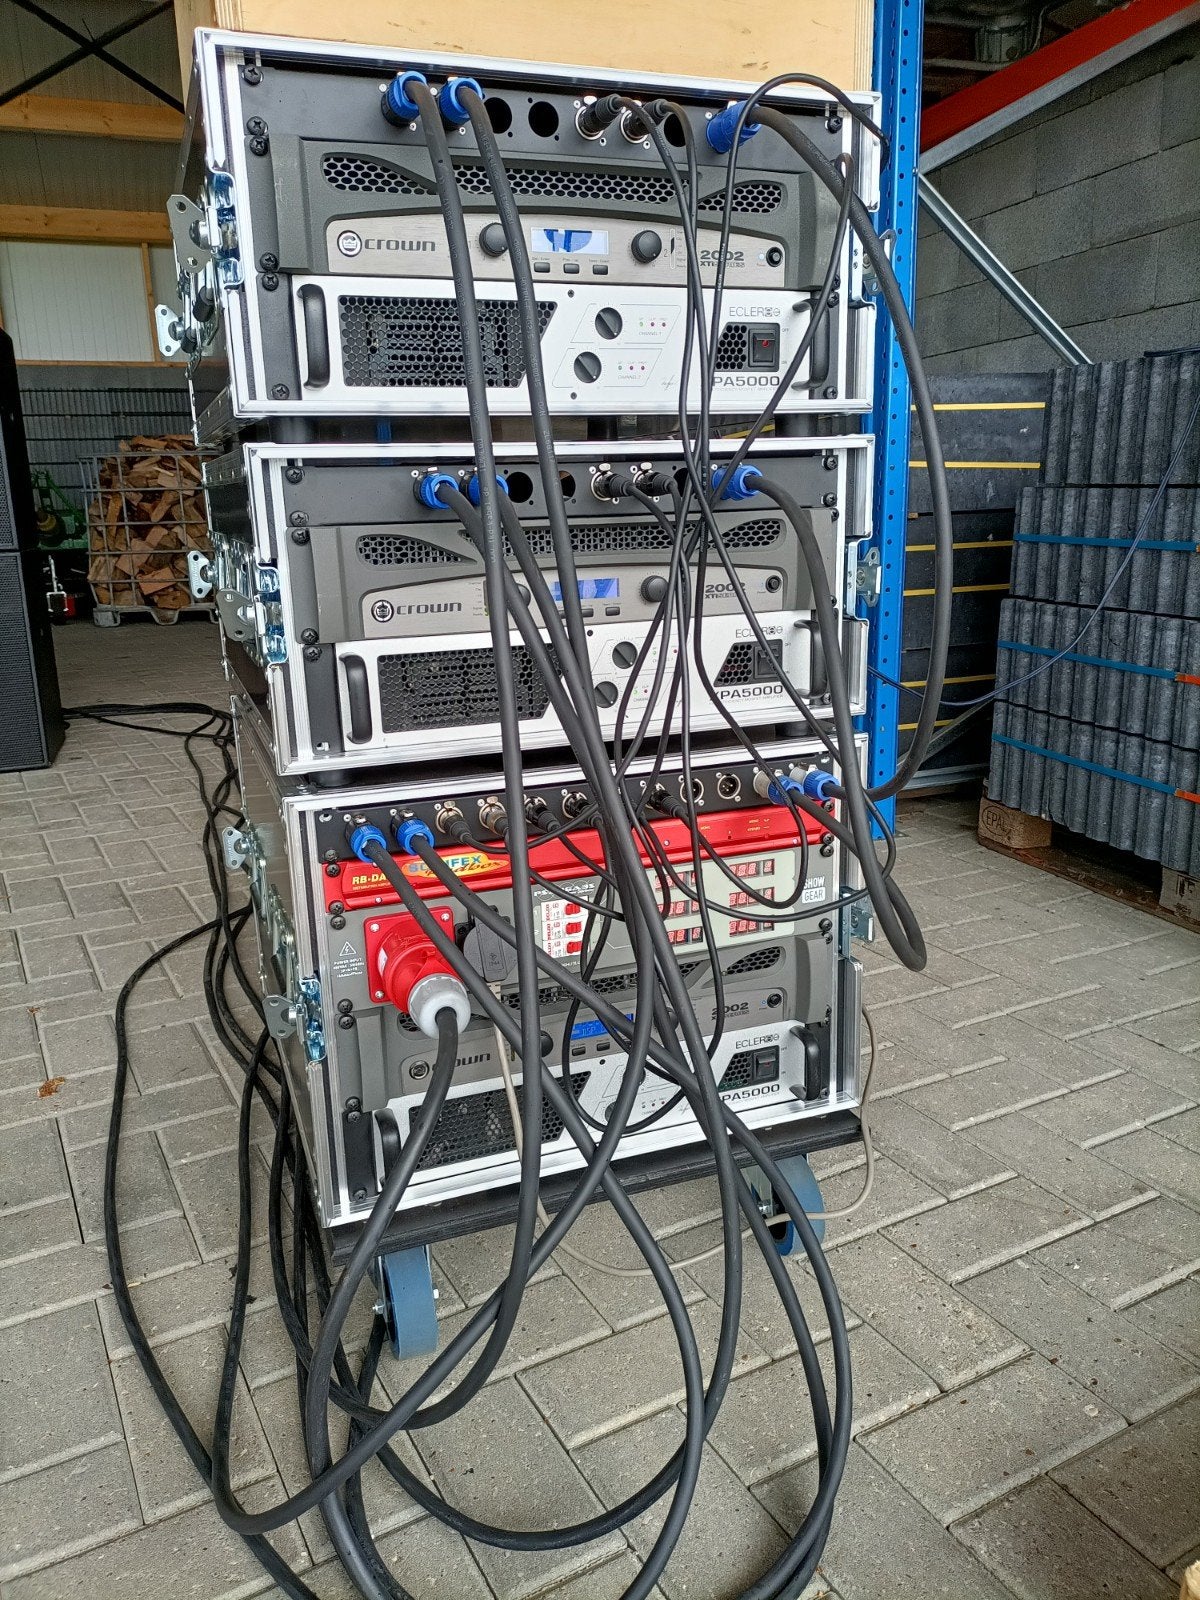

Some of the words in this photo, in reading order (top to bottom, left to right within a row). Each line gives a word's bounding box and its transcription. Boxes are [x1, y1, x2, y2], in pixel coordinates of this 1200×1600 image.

[364, 238, 436, 252] crown
[700, 250, 744, 261] 2002
[729, 306, 764, 317] ECLER
[711, 376, 780, 387] PA5000
[396, 602, 462, 615] crown
[735, 626, 767, 638] ECLR
[709, 684, 783, 701] PA5000
[803, 876, 825, 889] SHOW
[805, 889, 824, 901] GEAR
[735, 1034, 765, 1049] ECLER
